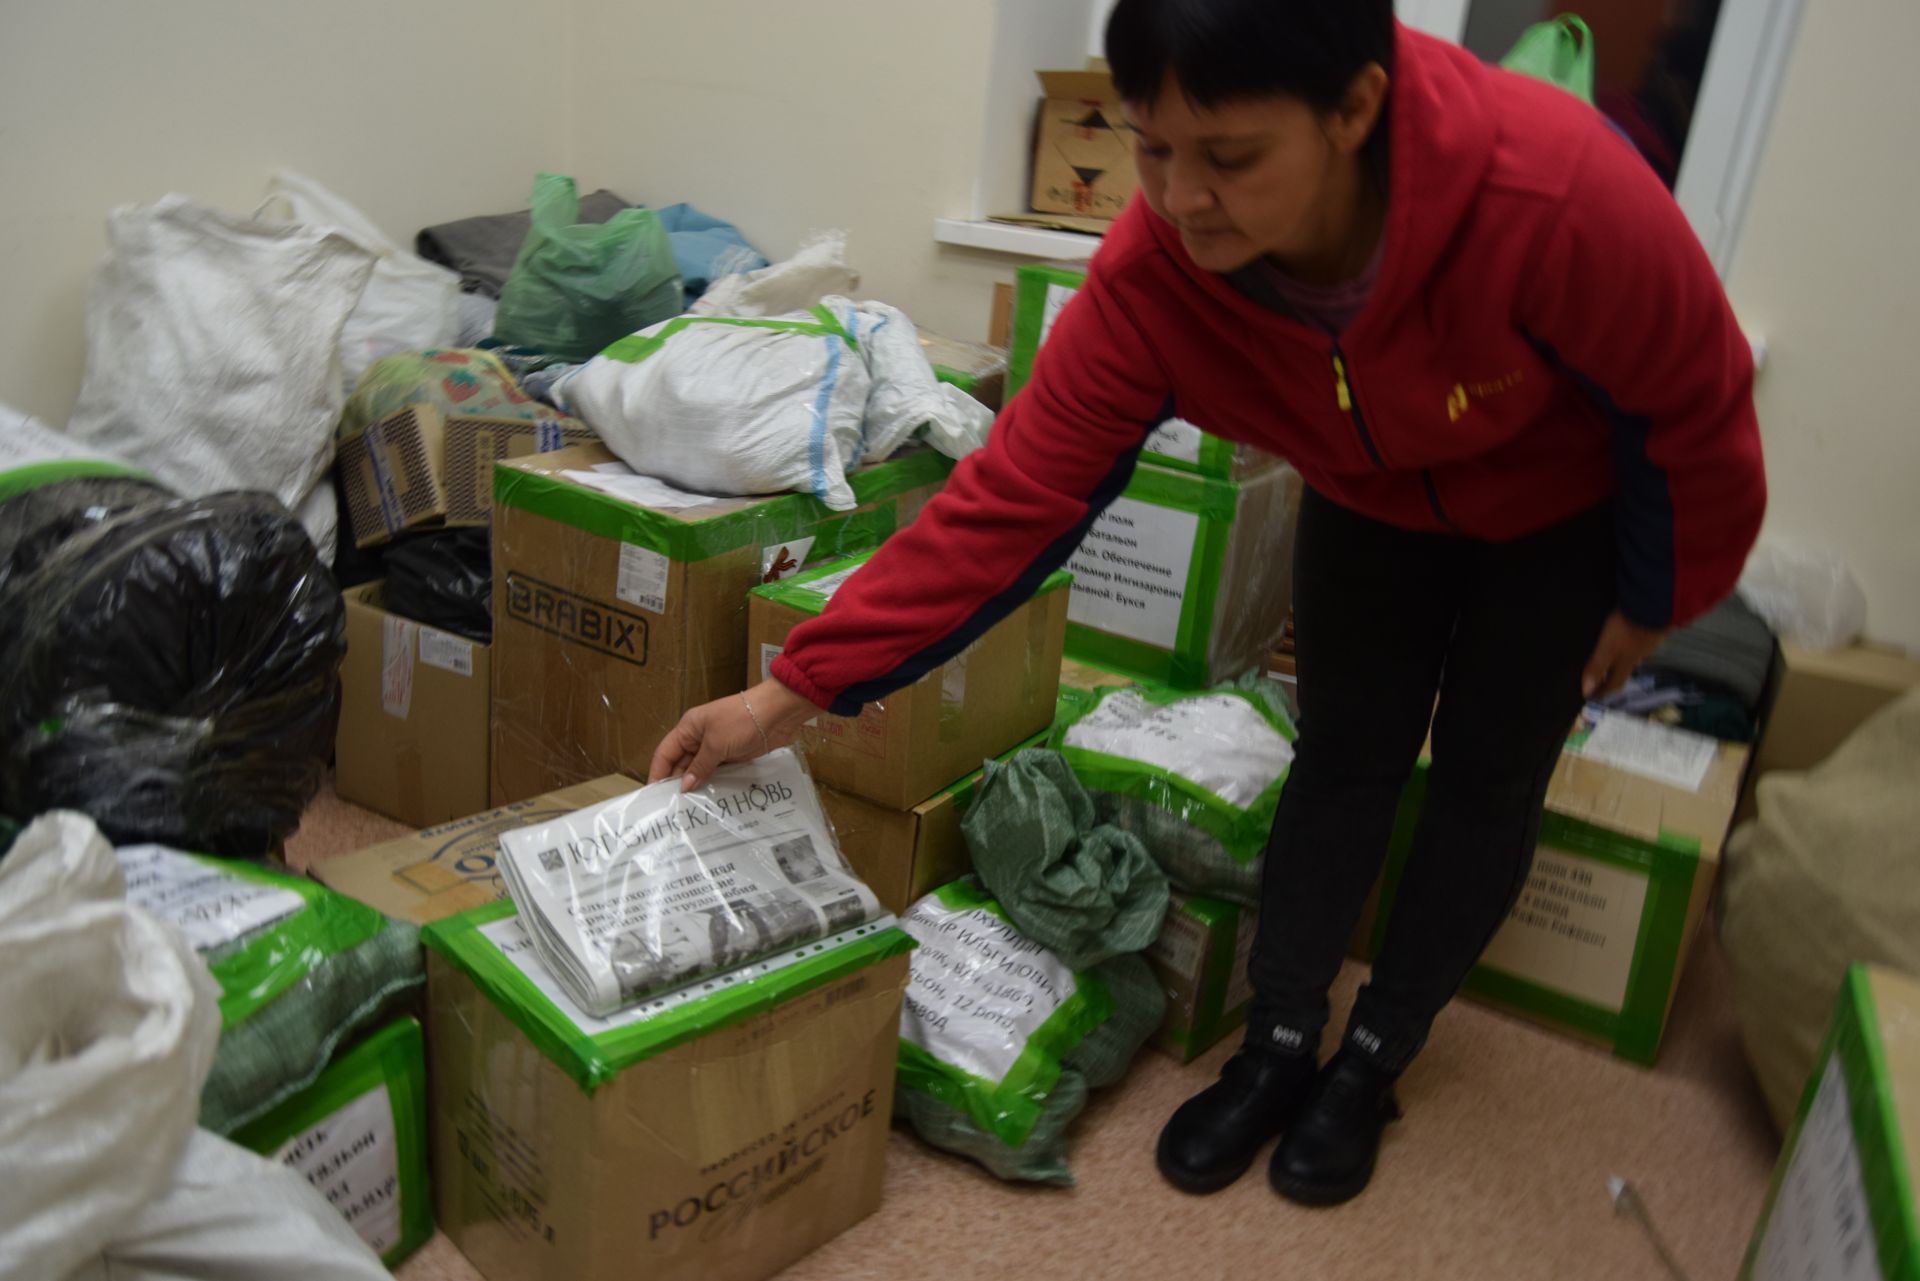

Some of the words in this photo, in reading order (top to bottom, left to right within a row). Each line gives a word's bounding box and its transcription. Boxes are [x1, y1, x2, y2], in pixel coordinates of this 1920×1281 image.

[1072, 582, 1113, 599] зывной:
[511, 580, 636, 655] BRABIX
[733, 780, 794, 817] НОВЬ
[921, 944, 950, 968] олк,
[952, 994, 975, 1010] 12
[649, 1088, 877, 1241] РОССИЙСКОЕ
